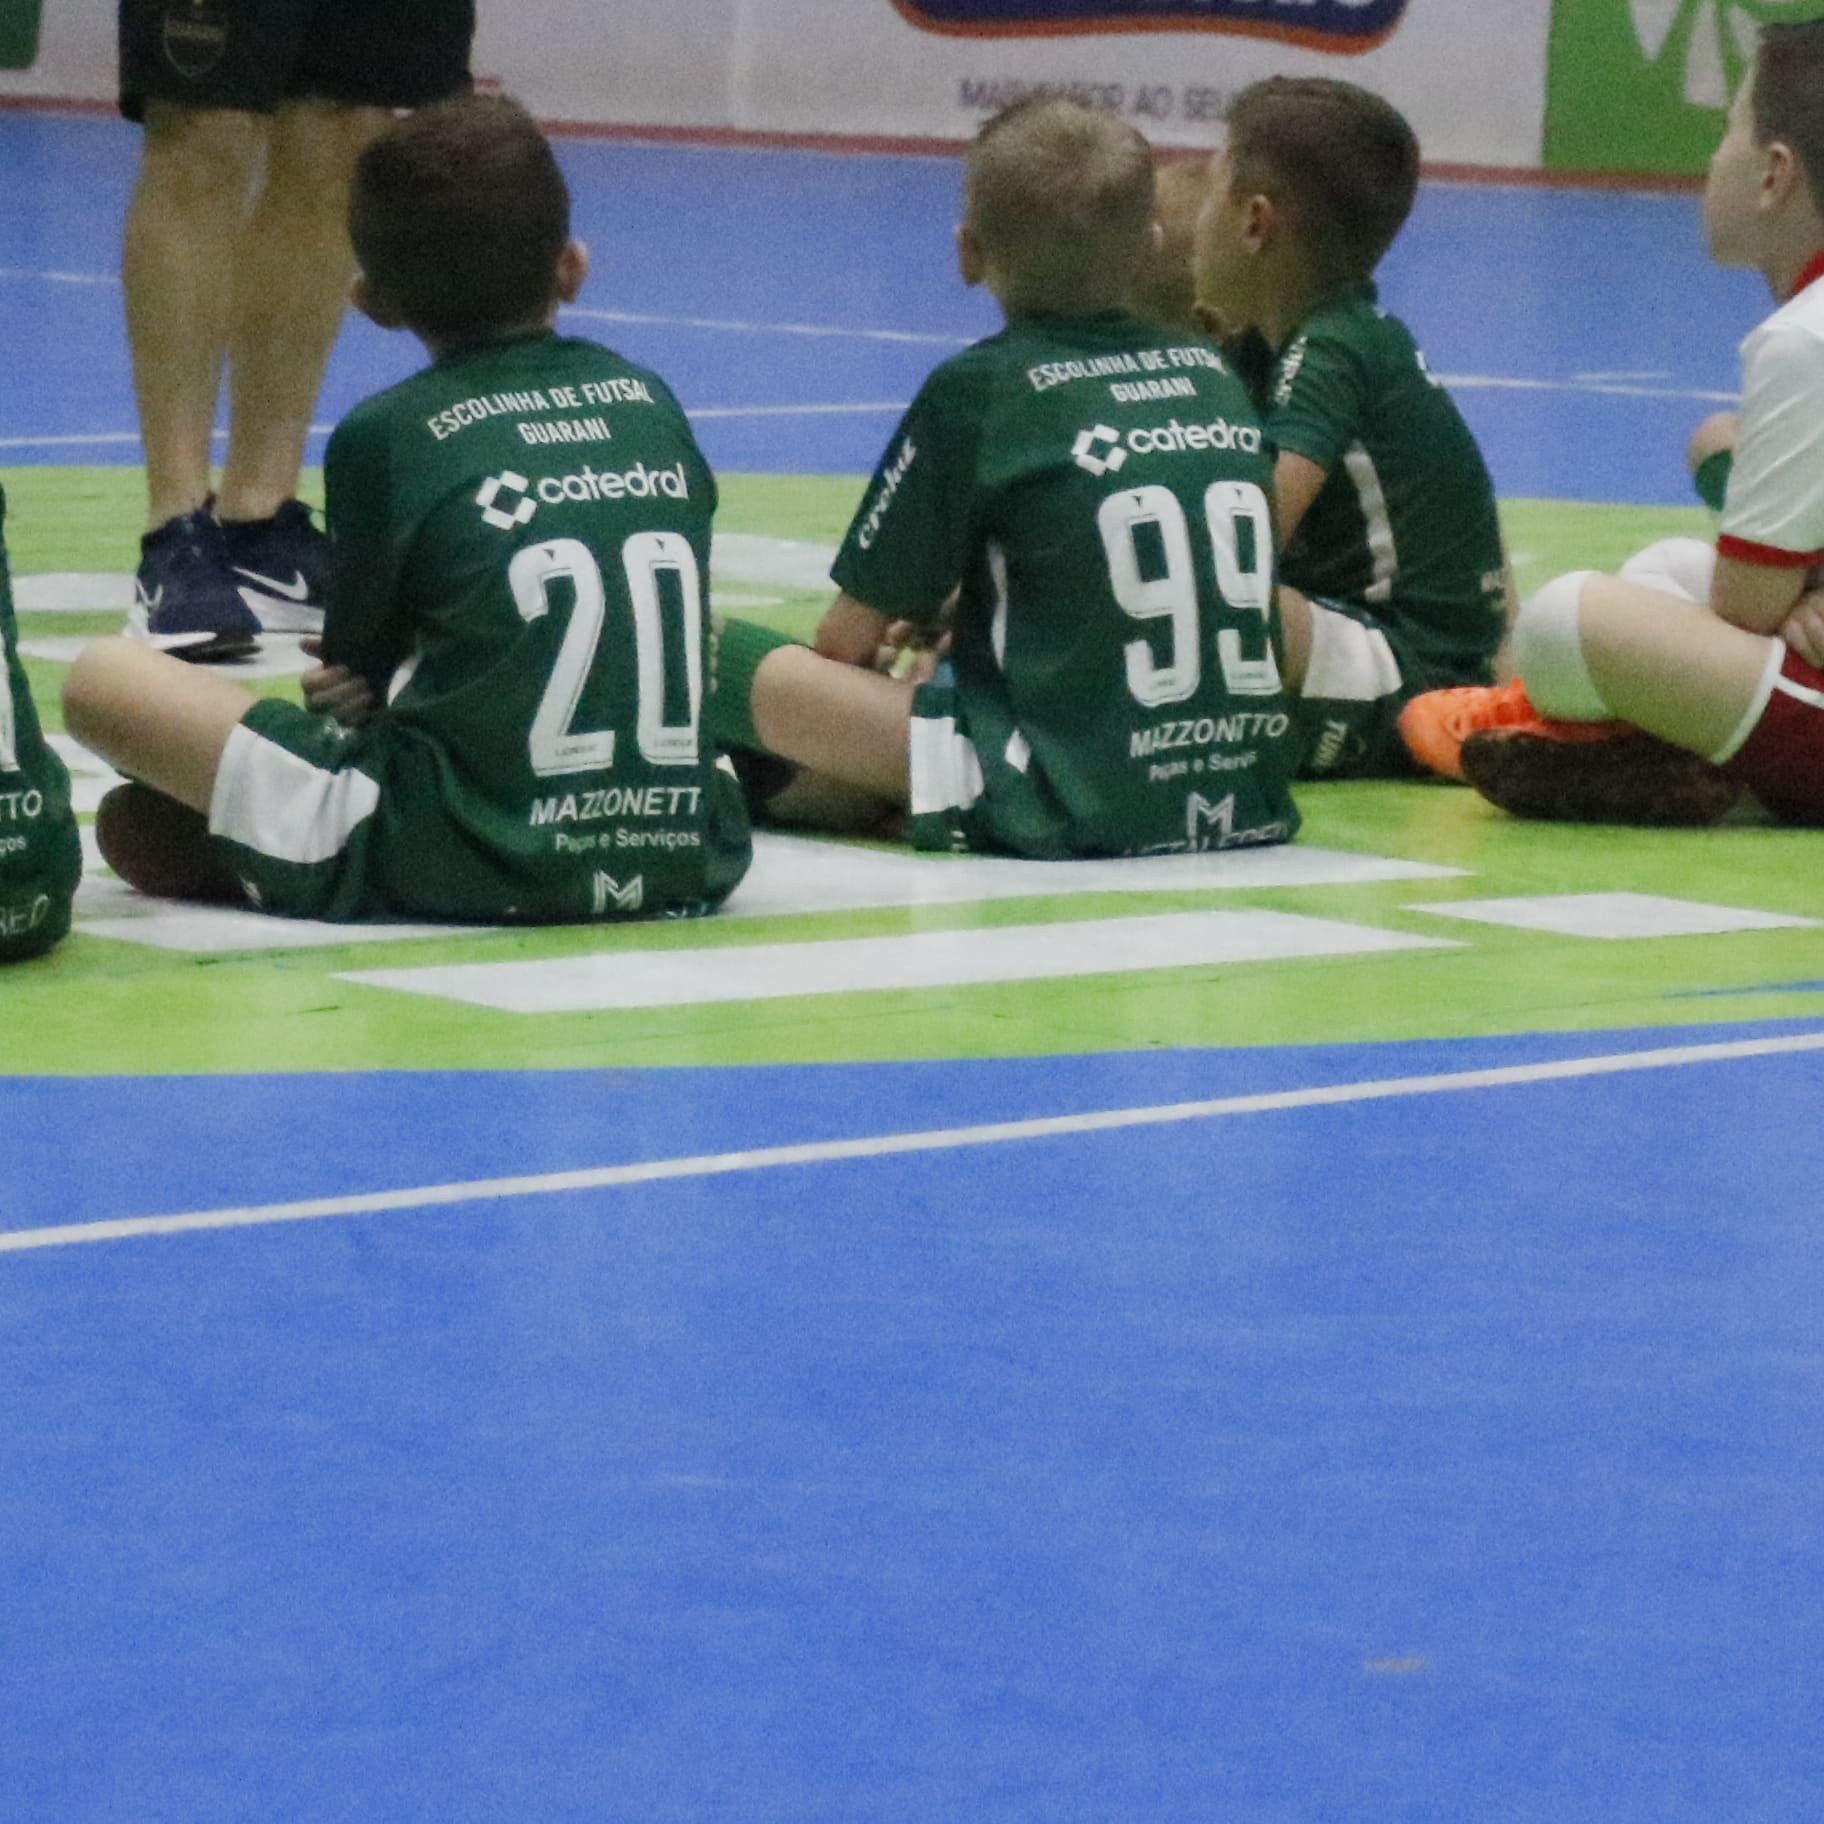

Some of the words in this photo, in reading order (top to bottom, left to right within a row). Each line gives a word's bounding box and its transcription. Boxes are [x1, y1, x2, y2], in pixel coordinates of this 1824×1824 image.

[1138, 348, 1166, 373] DE
[1110, 376, 1198, 404] GUARANI
[427, 388, 551, 441] ESCOLINHA
[549, 384, 581, 410] DE
[517, 418, 612, 446] GUARANI
[537, 462, 688, 505] catedral
[1095, 479, 1282, 711] 99
[507, 530, 703, 778] 20
